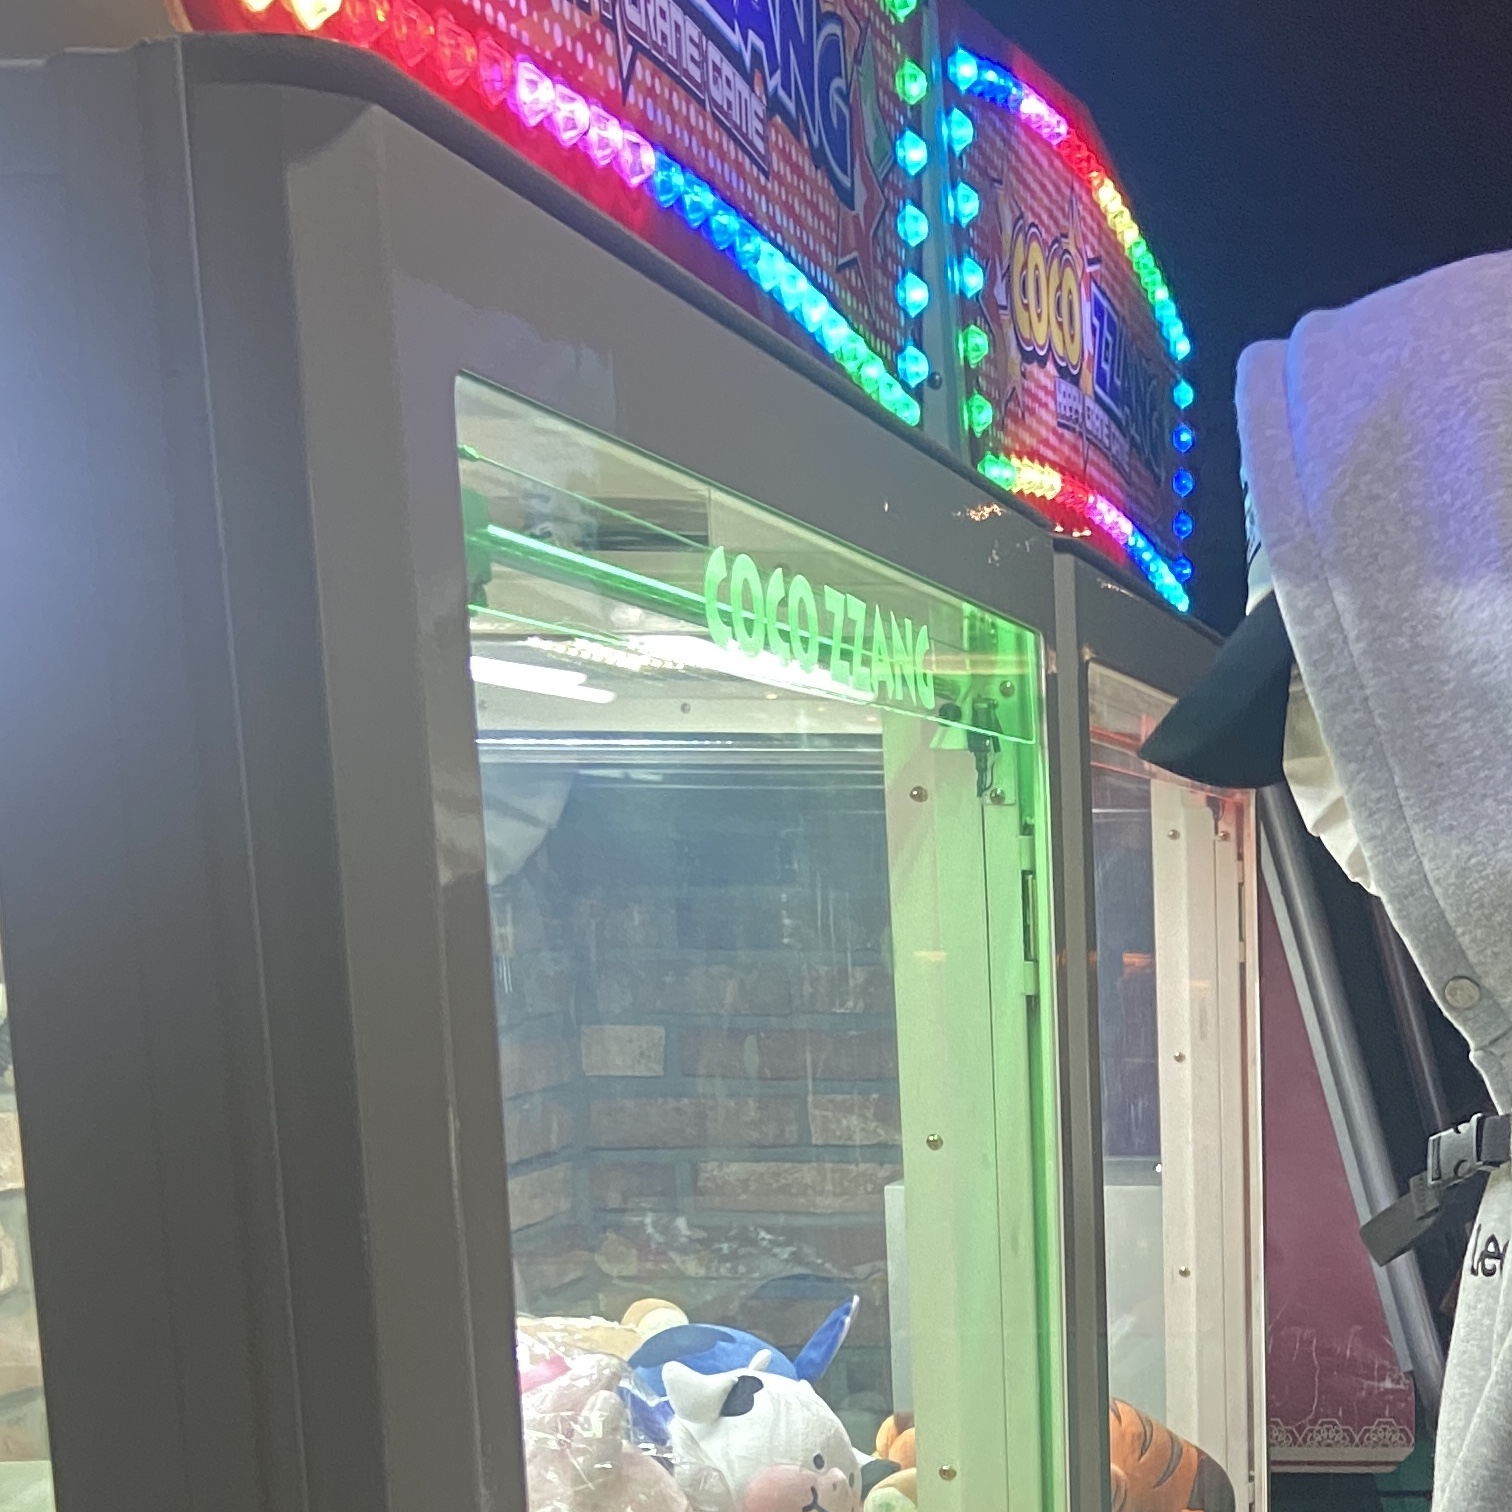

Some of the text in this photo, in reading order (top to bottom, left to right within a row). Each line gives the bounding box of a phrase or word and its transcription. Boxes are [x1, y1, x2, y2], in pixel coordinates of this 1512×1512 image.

[706, 39, 766, 154] GAME
[1010, 221, 1083, 376] COCO
[704, 545, 936, 710] COCO ZZANG
